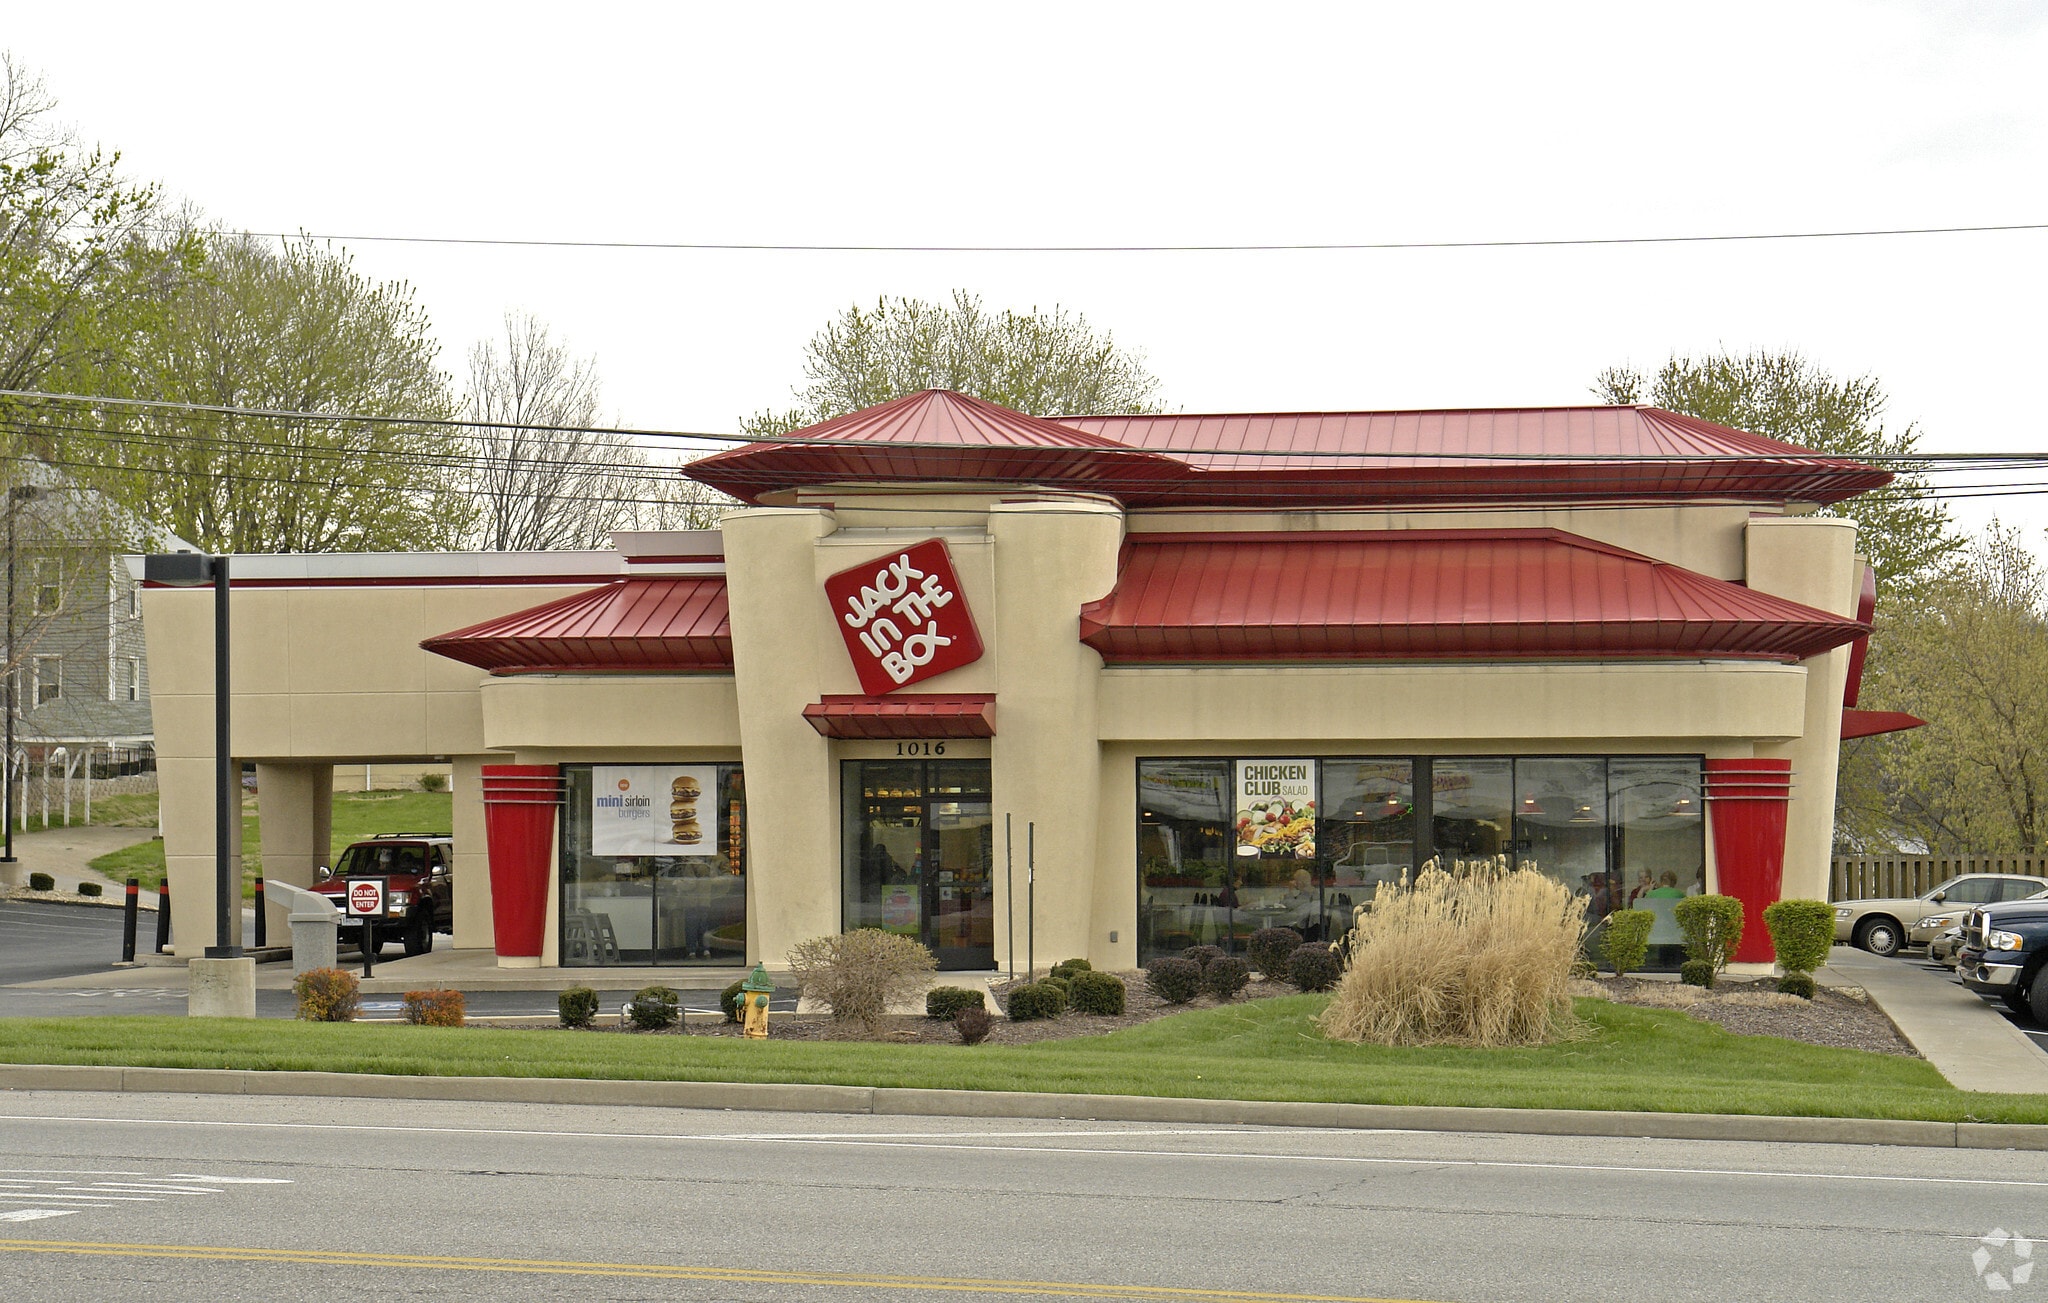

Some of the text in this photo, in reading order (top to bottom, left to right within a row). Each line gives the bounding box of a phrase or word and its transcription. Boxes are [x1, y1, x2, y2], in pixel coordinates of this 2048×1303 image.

[844, 553, 924, 628] JACK
[892, 574, 953, 626] THE
[881, 620, 951, 684] BOX
[896, 741, 945, 756] 1016
[1244, 765, 1307, 780] CHICKEN
[1244, 781, 1308, 796] CLUB SALAD
[596, 794, 650, 807] mini sirloin
[618, 808, 650, 820] burgers
[353, 889, 376, 897] DO NOT
